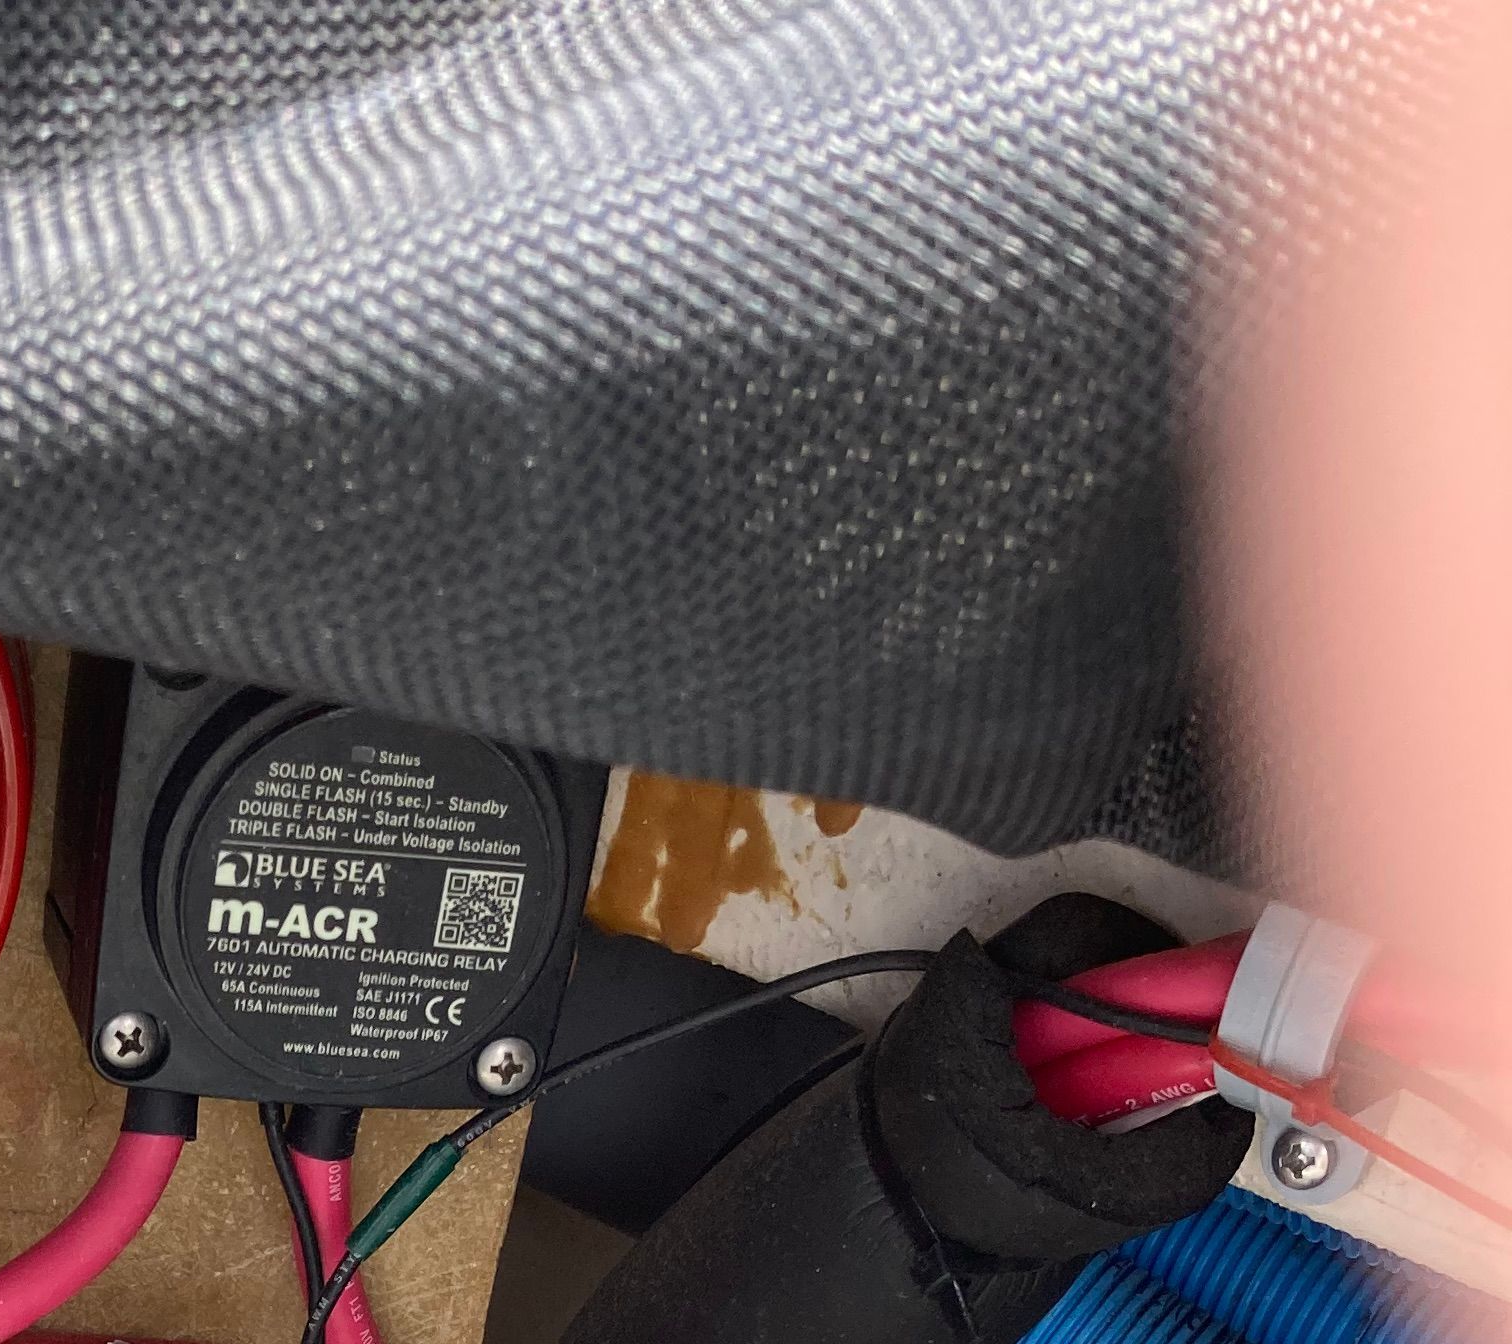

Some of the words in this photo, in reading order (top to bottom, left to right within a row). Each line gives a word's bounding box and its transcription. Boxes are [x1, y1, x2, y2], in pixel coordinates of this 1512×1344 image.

[379, 751, 421, 768] Status
[269, 763, 316, 780] SOLID
[320, 768, 343, 782] ON
[360, 769, 435, 790] Combined
[255, 782, 311, 800] SINGLE
[315, 785, 366, 803] FLASH
[370, 791, 392, 808] (15
[396, 795, 431, 812] sec.)
[448, 797, 508, 818] Standby
[238, 800, 302, 819] DOUBLE
[307, 806, 358, 823] FLASH
[374, 811, 409, 827] Start
[413, 813, 476, 832] Isolation
[229, 818, 281, 837] TRIPLE
[286, 822, 337, 841] FLASH
[354, 829, 397, 847] Under
[402, 834, 454, 854] Voltage
[458, 836, 521, 855] Isolation
[255, 853, 328, 880] BLUE
[207, 898, 379, 944] m-ACR
[207, 936, 250, 954] 7601
[255, 940, 356, 961] AUTOMATIC
[360, 948, 448, 968] CHARGING
[453, 954, 507, 972] RELAY
[213, 961, 236, 975] 12V
[246, 963, 270, 978] 24V
[273, 965, 292, 979] DC
[358, 971, 406, 987] Ignition
[409, 974, 470, 992] Protected
[222, 980, 245, 994] 65A
[249, 981, 320, 998] Continuous
[356, 988, 382, 1003] SAE
[385, 991, 421, 1006] J1171
[234, 998, 263, 1013] 115A
[266, 1000, 338, 1018] Intermittent
[352, 1005, 376, 1020] ISO
[378, 1008, 408, 1022] 8846
[425, 995, 466, 1026] CE
[350, 1023, 419, 1042] Waterproof
[421, 1028, 448, 1042] IP67
[283, 1042, 401, 1060] www.bluesea.com
[1150, 1082, 1197, 1108] AWG
[348, 1296, 365, 1324] FT1
